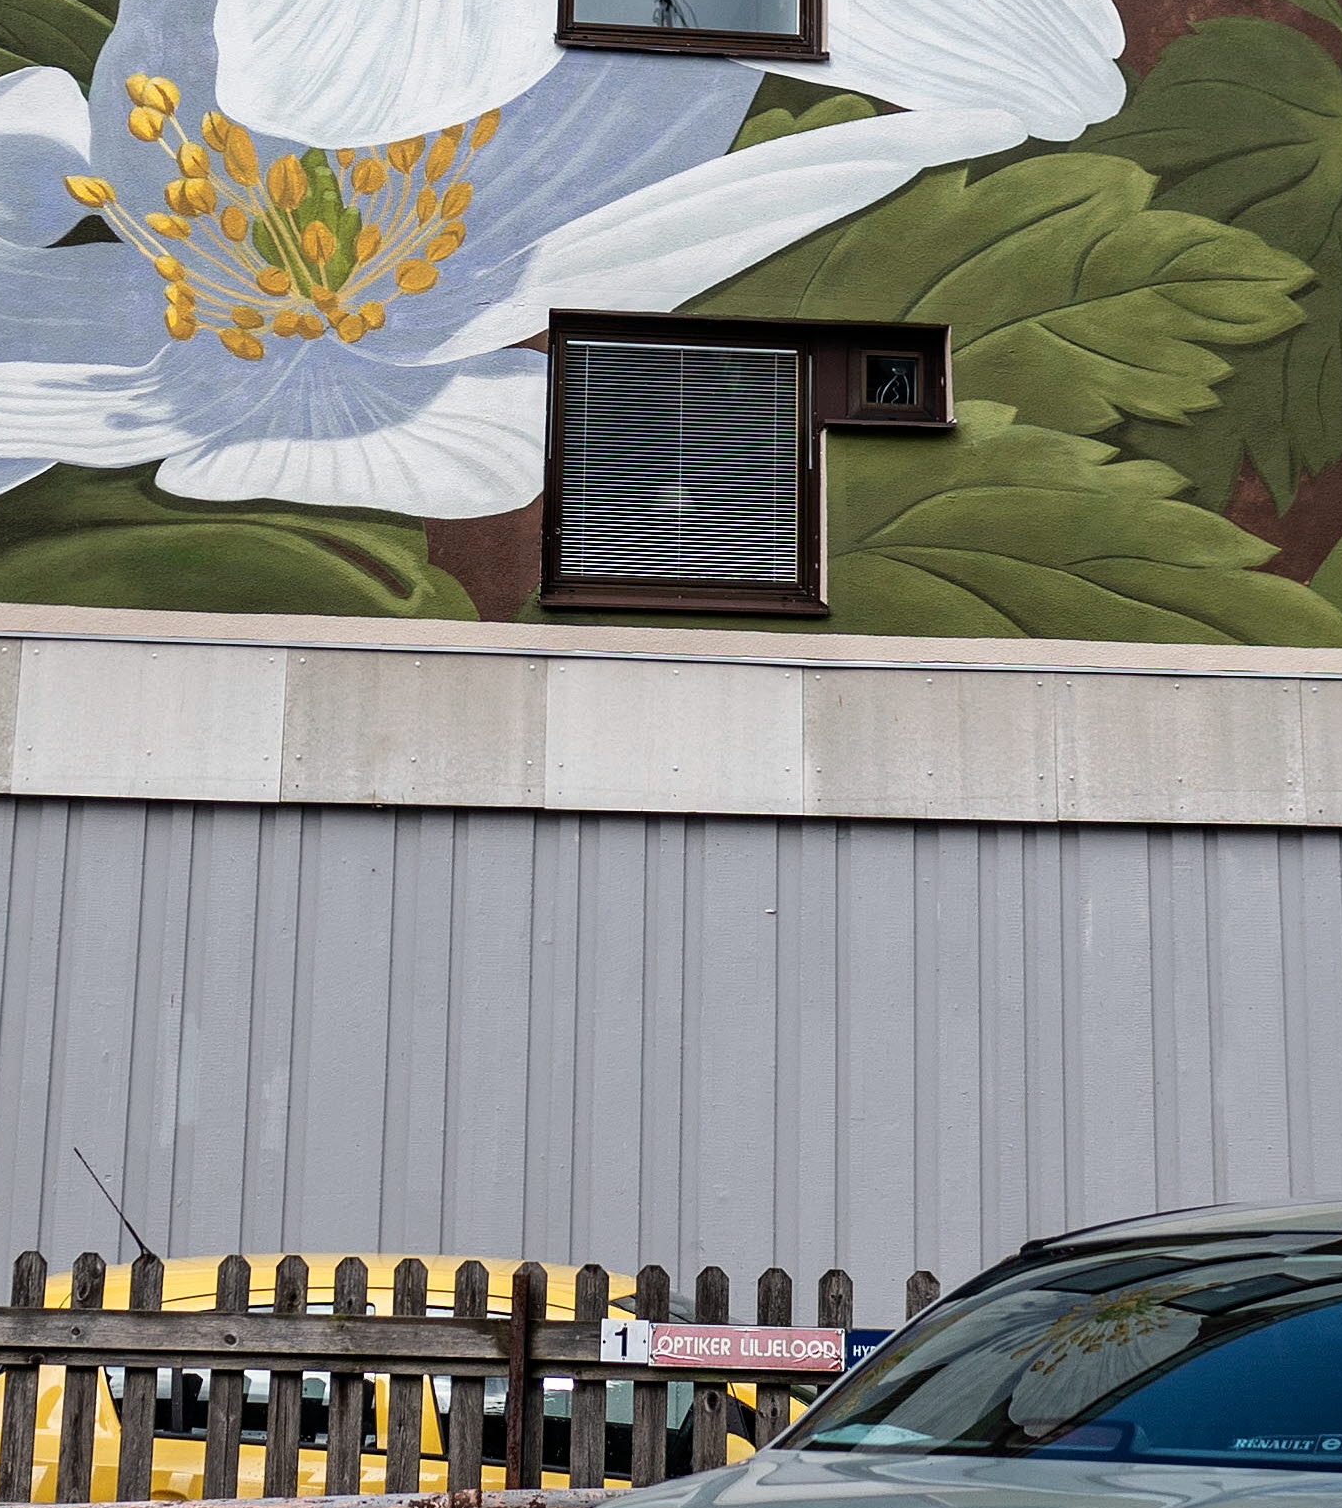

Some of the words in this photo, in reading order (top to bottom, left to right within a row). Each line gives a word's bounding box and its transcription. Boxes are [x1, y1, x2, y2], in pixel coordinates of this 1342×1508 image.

[614, 1327, 628, 1358] 1
[657, 1335, 732, 1356] OPTIKER
[1233, 1438, 1314, 1451] RENAULT
